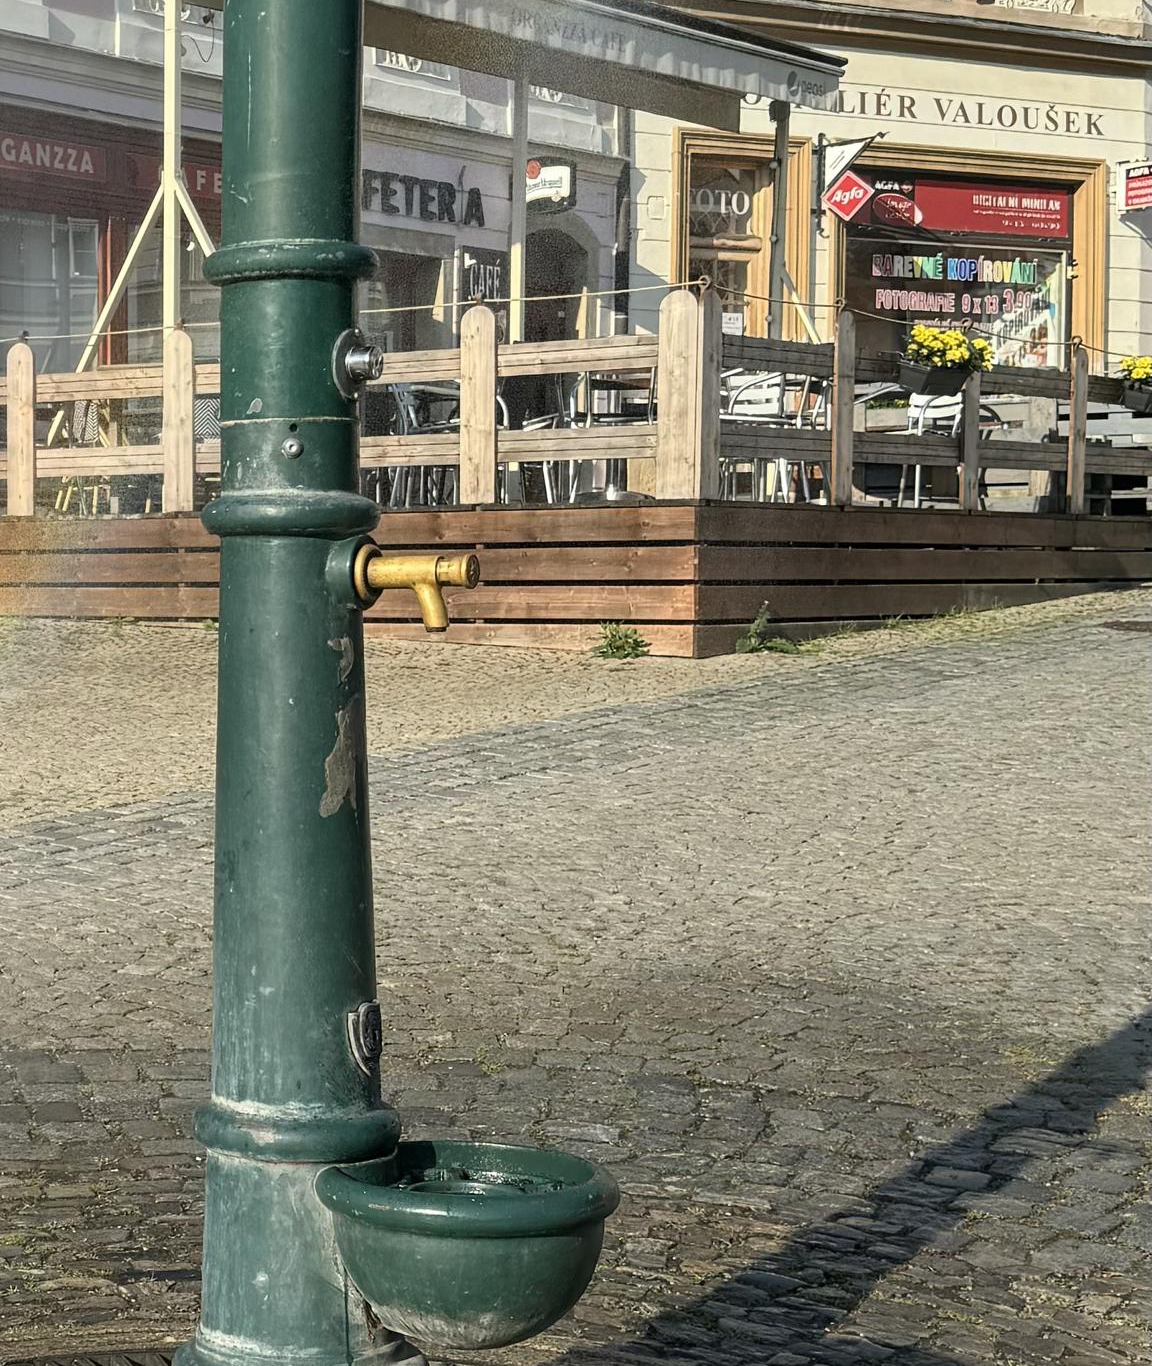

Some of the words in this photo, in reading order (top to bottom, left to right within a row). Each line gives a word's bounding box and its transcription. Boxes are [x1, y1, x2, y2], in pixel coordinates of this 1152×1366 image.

[933, 97, 1105, 136] VALOUŠEK
[830, 186, 866, 205] Agfa
[874, 180, 900, 191] AGFA
[470, 258, 501, 301] CAFÉ
[872, 252, 943, 280] BAREVNÉ
[948, 255, 1038, 284] KOPÍROVÁNÍ
[875, 289, 955, 313] FOTOGRAFIE
[961, 293, 971, 314] 9
